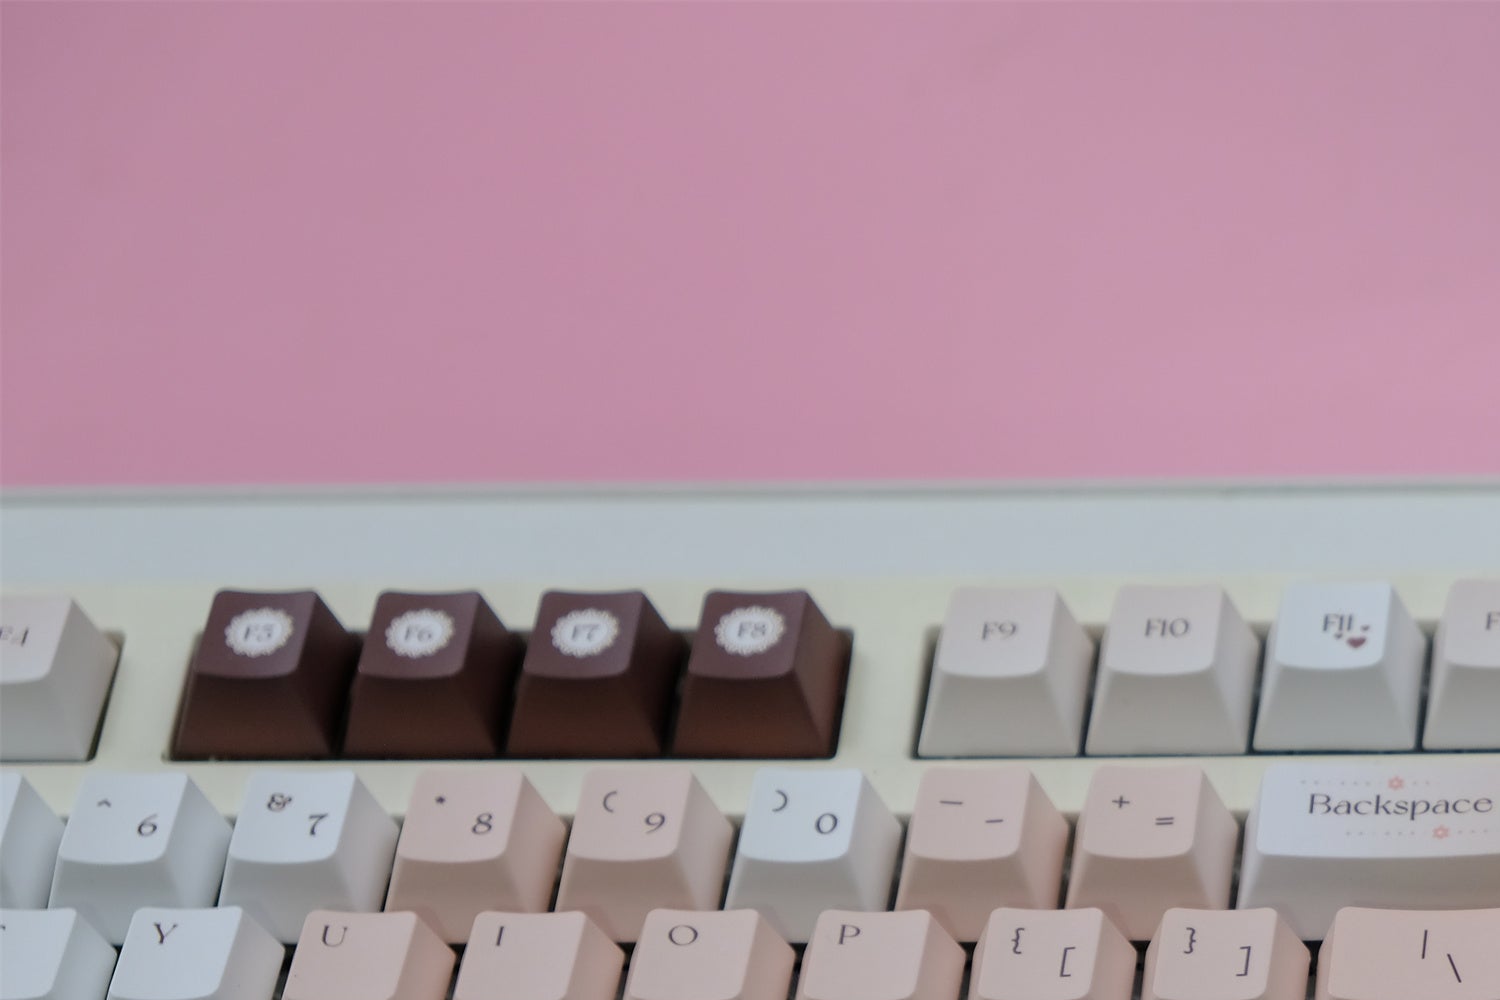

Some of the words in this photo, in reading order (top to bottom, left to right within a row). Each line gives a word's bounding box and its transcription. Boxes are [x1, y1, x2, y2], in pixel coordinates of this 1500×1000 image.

[570, 622, 601, 642] F7
[735, 620, 768, 640] F8
[981, 621, 1018, 641] F9
[1144, 618, 1191, 638] F10
[1321, 612, 1355, 633] F11
[266, 793, 293, 812] &
[602, 790, 618, 814] (
[772, 789, 789, 813] )
[1111, 795, 1131, 809] +
[1308, 793, 1493, 822] Backspace
[136, 814, 159, 837] 6
[308, 813, 328, 837] 7
[471, 813, 493, 835] 8
[644, 812, 666, 833] 9
[814, 812, 839, 835] 0
[1154, 816, 1175, 826] =
[153, 922, 178, 945] Y
[321, 924, 348, 946] U
[667, 925, 699, 946] O
[838, 924, 861, 946] P
[1011, 927, 1025, 955] {
[1183, 926, 1197, 955] }
[1059, 946, 1076, 978] [
[1235, 945, 1252, 977] ]
[1446, 953, 1462, 984] \
